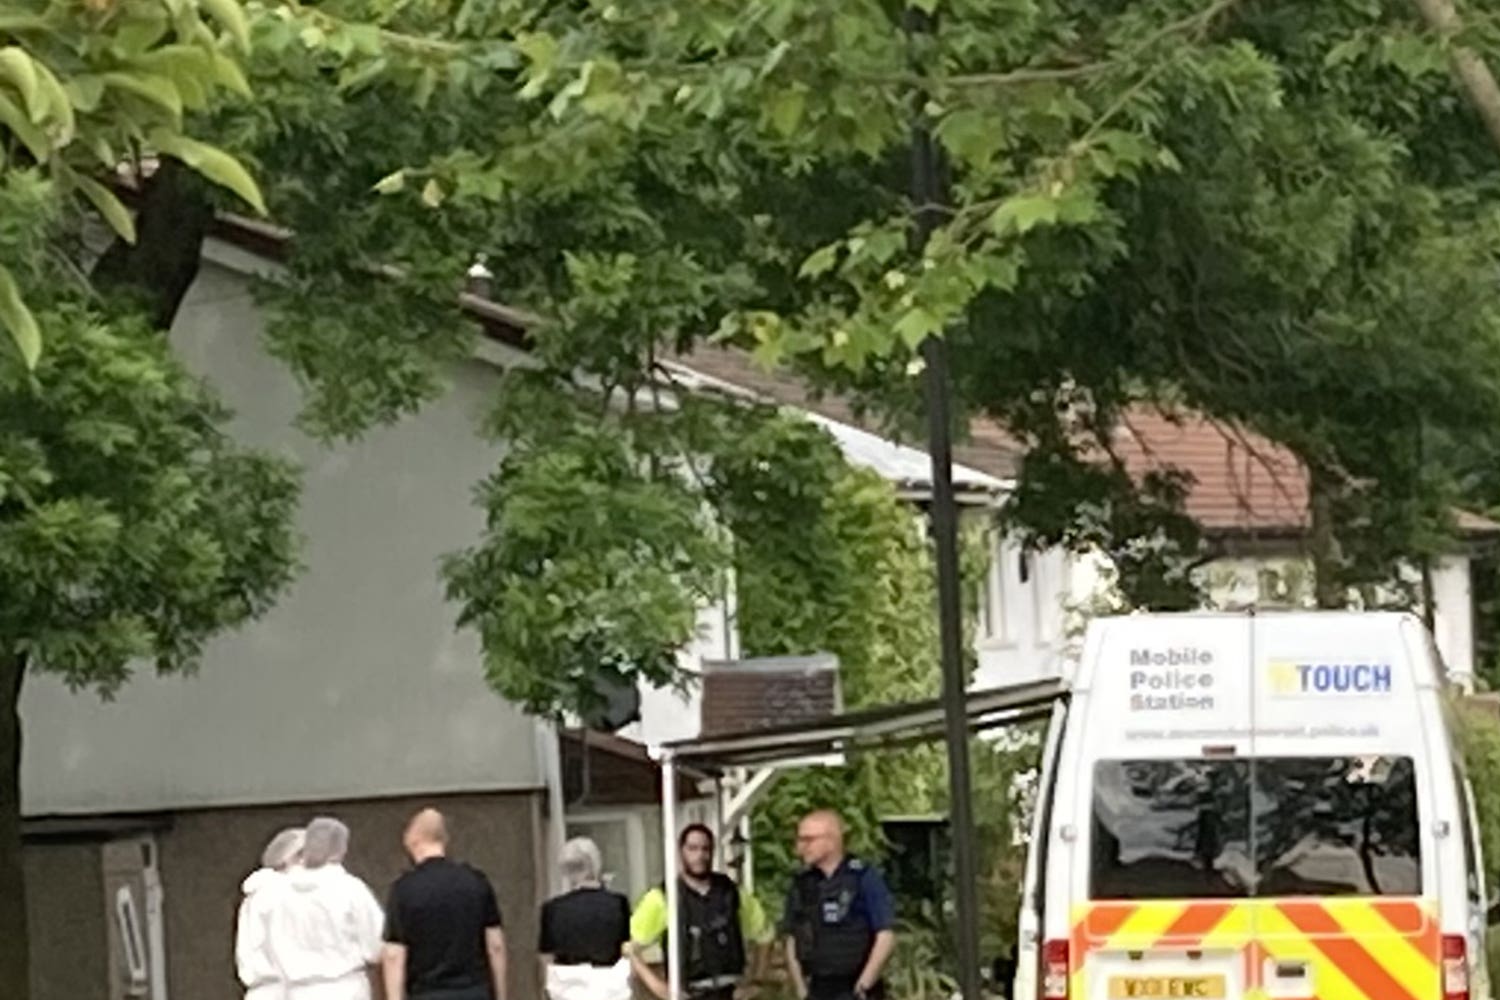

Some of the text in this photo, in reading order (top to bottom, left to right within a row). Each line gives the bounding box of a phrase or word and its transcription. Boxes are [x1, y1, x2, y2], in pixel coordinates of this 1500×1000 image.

[1130, 648, 1213, 666] Mobile
[1130, 669, 1213, 690] Police
[1130, 692, 1214, 712] Station
